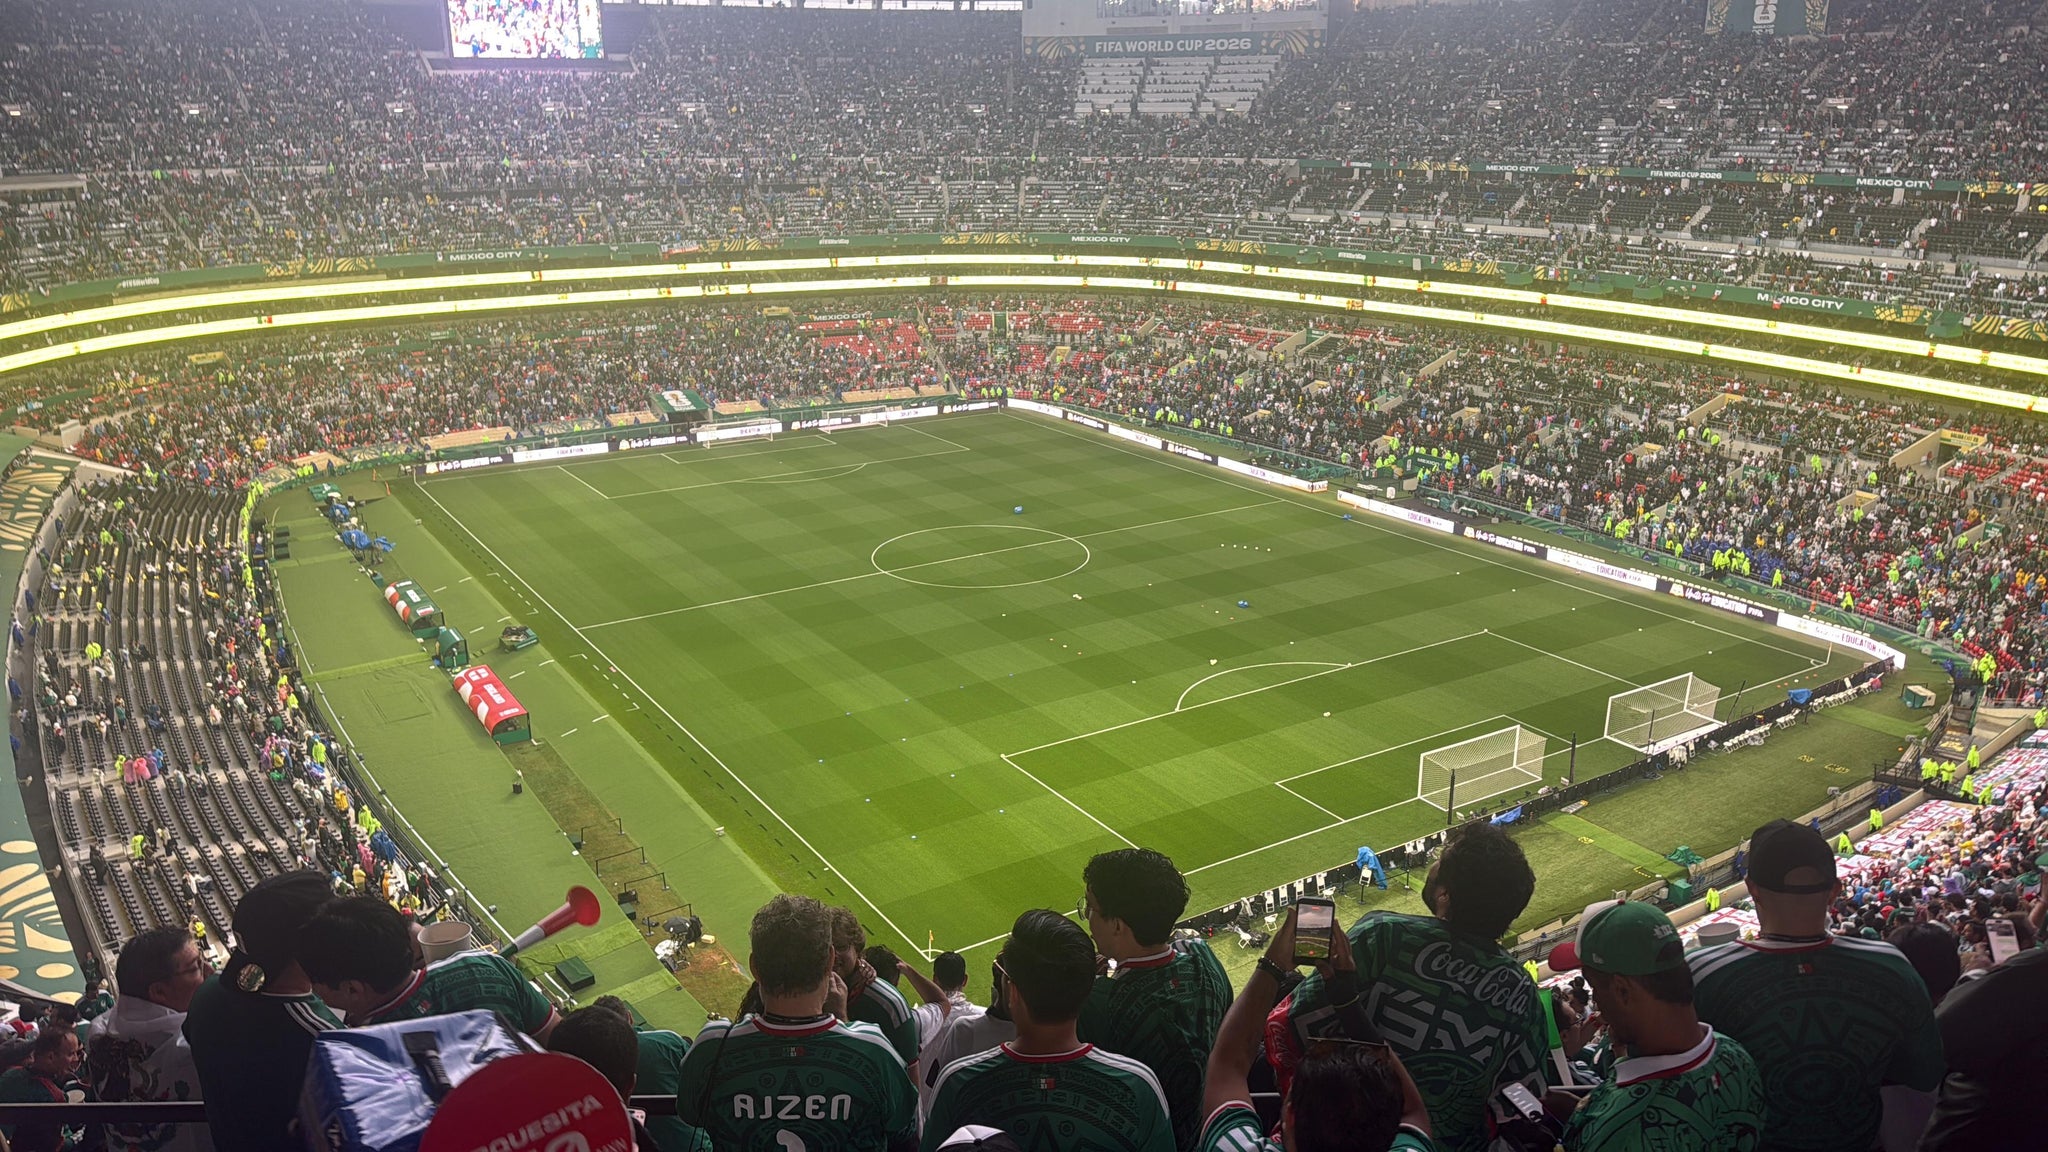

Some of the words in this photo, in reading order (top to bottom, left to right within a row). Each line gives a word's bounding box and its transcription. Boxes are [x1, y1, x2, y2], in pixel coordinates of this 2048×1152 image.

[1095, 41, 1123, 53] FIFA
[1125, 40, 1174, 52] WORLD
[1177, 39, 1203, 51] CUP
[1204, 38, 1252, 50] 2026
[1856, 178, 1903, 187] MEXICO
[450, 253, 494, 262] MEXICO
[496, 251, 522, 259] CITY
[1811, 298, 1844, 310] CITY
[1710, 595, 1748, 615] EDUCATION
[1747, 606, 1764, 618] FIFA
[1841, 632, 1877, 653] EDUCATION
[1415, 941, 1529, 1016] Coca-Cola
[733, 1093, 852, 1121] AJZEN
[472, 1093, 604, 1152] QUESITA
